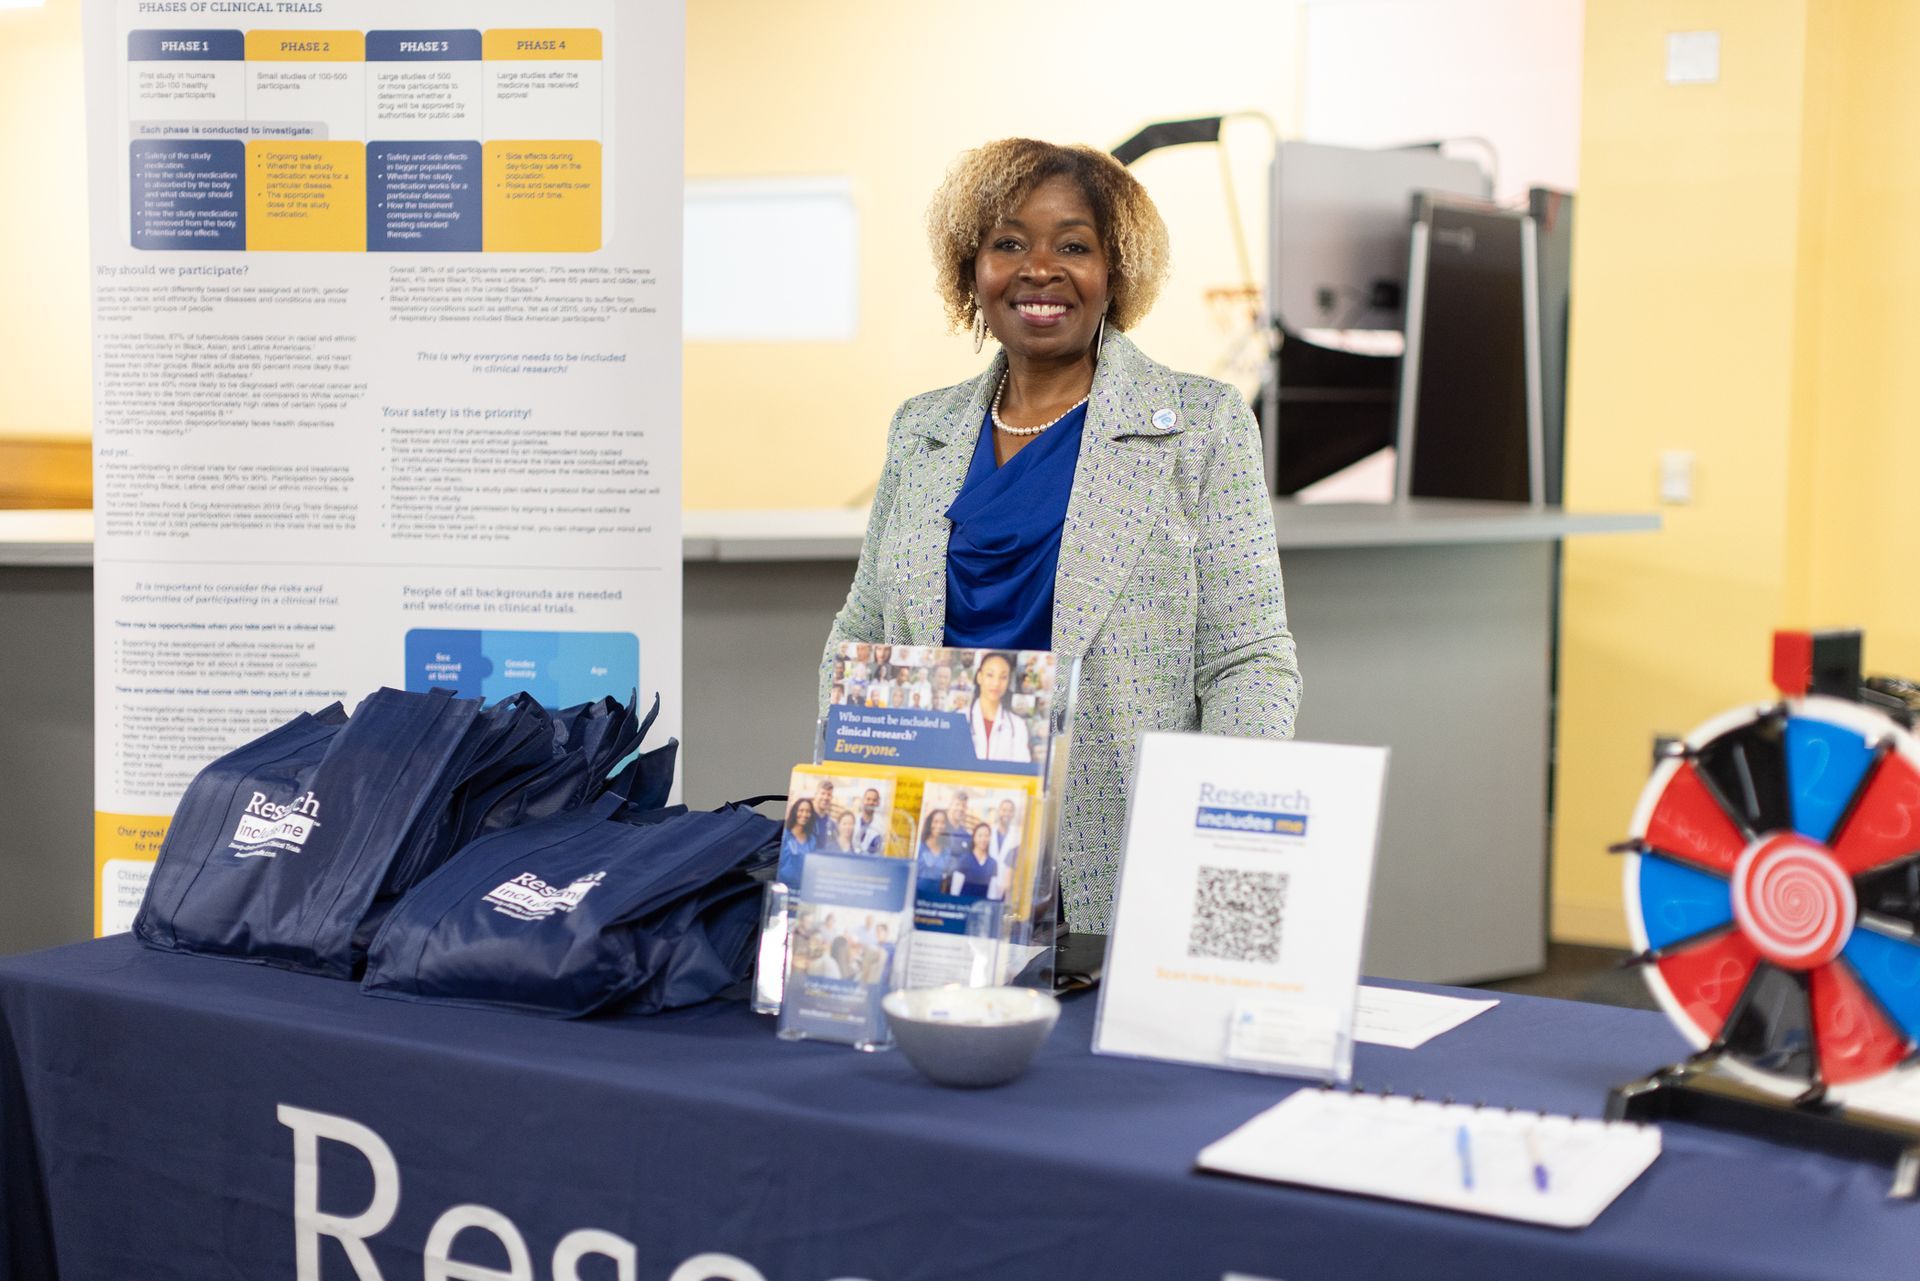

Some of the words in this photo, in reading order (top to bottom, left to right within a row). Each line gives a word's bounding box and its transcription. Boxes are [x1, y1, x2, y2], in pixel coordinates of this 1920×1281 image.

[139, 2, 187, 13] PHASES
[190, 3, 207, 13] OF
[210, 3, 273, 13] CLINICAL
[276, 3, 322, 13] TRIALS
[161, 41, 200, 51] PHASE
[202, 41, 209, 51] 1
[280, 42, 320, 52] PHASE
[322, 42, 329, 52] 2
[400, 41, 439, 52] PHASE
[441, 41, 449, 52] 3
[516, 41, 556, 51] PHASE
[558, 41, 566, 51] 4
[140, 126, 161, 134] Each
[162, 126, 190, 136] phase
[191, 126, 200, 134] is
[201, 126, 249, 134] conducted
[261, 127, 313, 136] investigate:
[96, 265, 117, 278] Why
[119, 265, 156, 275] should
[158, 267, 176, 275] we
[178, 266, 249, 278] participate?
[417, 352, 438, 361] This
[439, 352, 448, 361] is
[450, 352, 471, 363] why
[473, 354, 519, 364] everyone
[521, 353, 551, 362] needs
[553, 353, 563, 362] to
[565, 353, 578, 362] be
[580, 353, 626, 362] included
[472, 364, 482, 373] in
[484, 364, 520, 373] clinical
[522, 364, 568, 373] research!
[381, 407, 409, 417] Your
[411, 408, 447, 420] safety
[449, 408, 460, 418] is
[462, 408, 482, 418] the
[484, 408, 533, 420] priority!
[136, 582, 142, 591] It
[143, 582, 152, 591] is
[153, 583, 202, 594] important
[203, 583, 214, 592] to
[215, 583, 259, 592] consider
[260, 584, 277, 593] the
[278, 584, 302, 593] risks
[303, 584, 322, 593] and
[403, 587, 442, 599] People
[444, 588, 457, 597] of
[458, 588, 473, 597] all
[475, 588, 553, 601] backgrounds
[555, 591, 575, 599] are
[576, 590, 622, 600] needed
[403, 602, 425, 611] and
[427, 602, 481, 612] welcome
[483, 603, 495, 612] in
[498, 604, 541, 613] clinical
[544, 604, 576, 614] trials.
[505, 659, 536, 668] Gender
[504, 669, 537, 680] identity
[590, 666, 608, 677] Age
[839, 712, 860, 722] Who
[862, 714, 885, 724] must
[887, 714, 899, 725] be
[900, 715, 938, 728] included
[940, 719, 950, 729] in
[837, 727, 870, 738] clinical
[872, 730, 917, 740] research?
[835, 740, 900, 758] Everyone.
[1199, 781, 1311, 811] Research
[1198, 809, 1273, 831] includes
[1275, 819, 1305, 832] me
[118, 827, 136, 836] Our
[140, 828, 164, 838] goal
